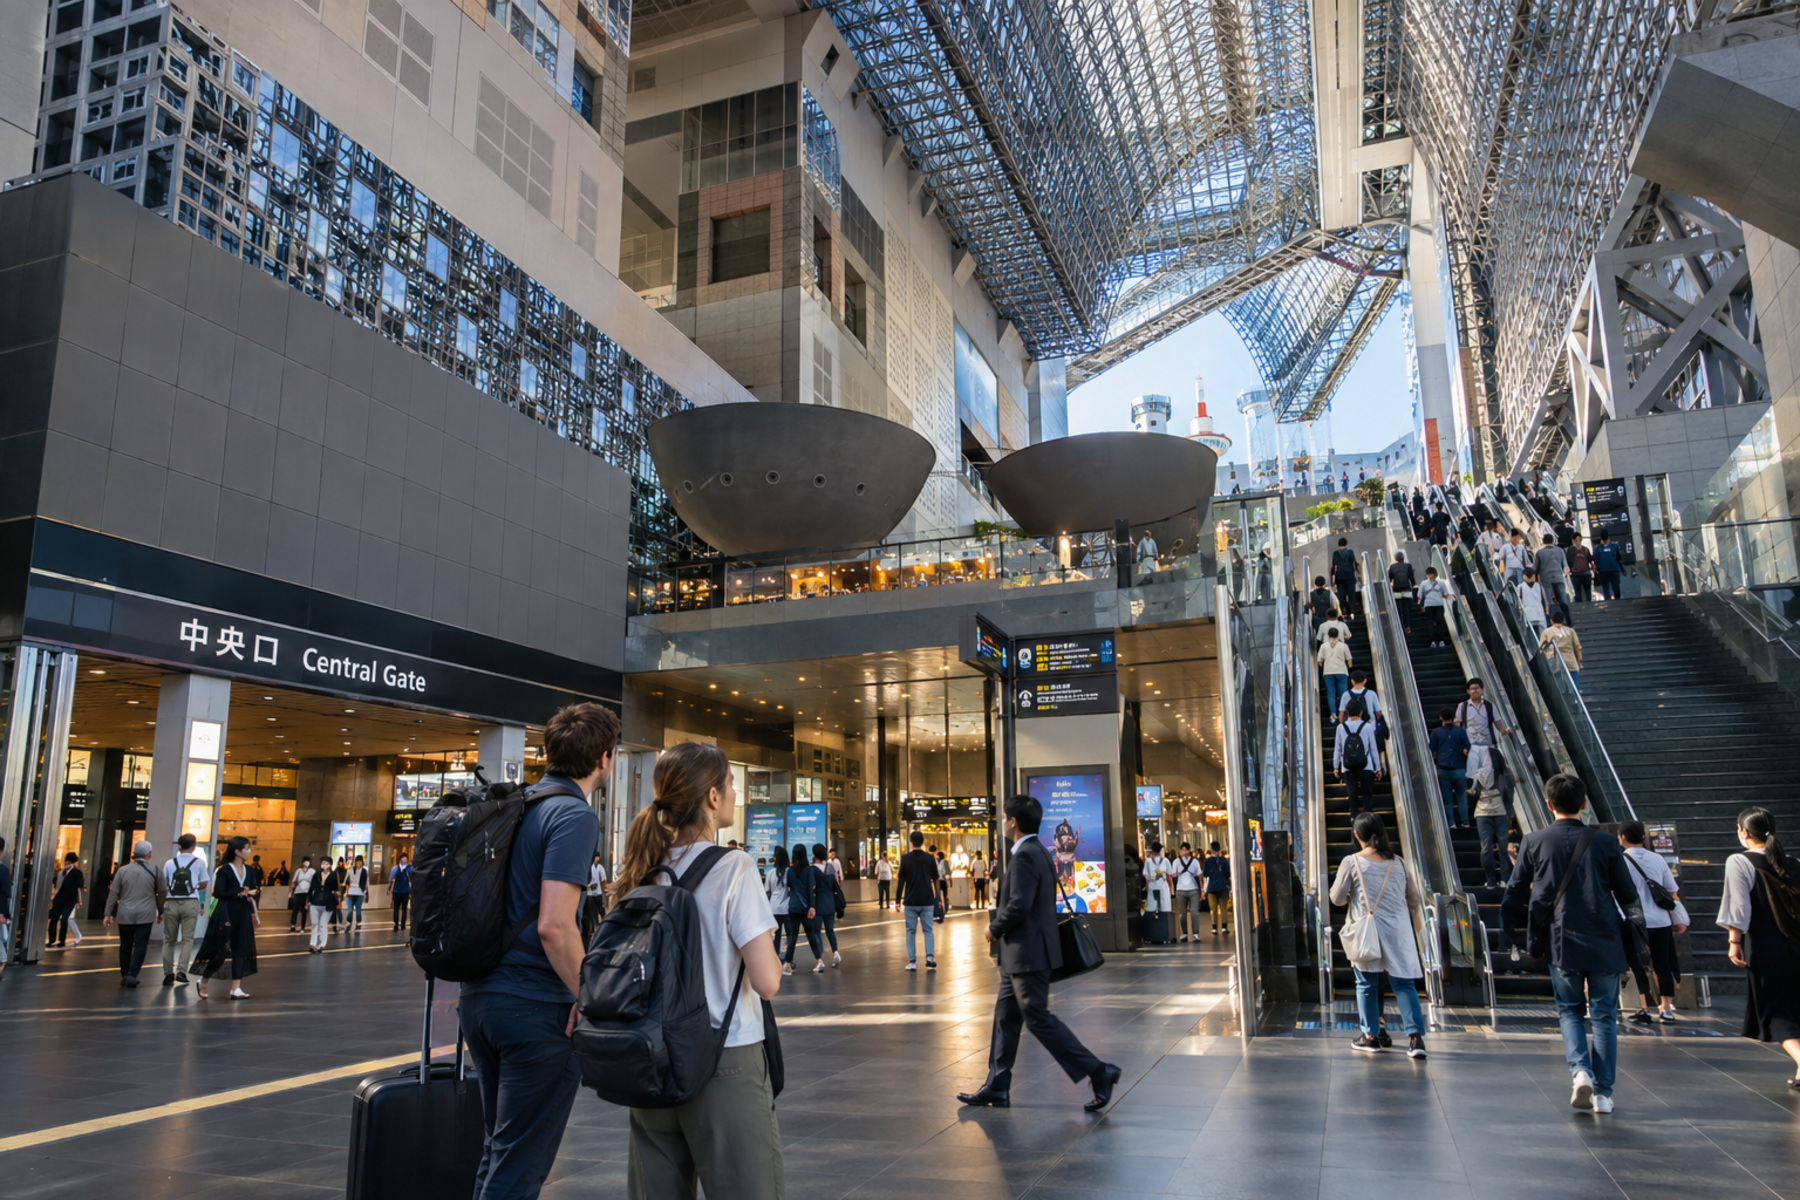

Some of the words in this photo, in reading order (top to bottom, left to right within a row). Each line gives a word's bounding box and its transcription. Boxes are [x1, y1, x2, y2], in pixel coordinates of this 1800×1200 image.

[179, 618, 279, 666] 中央口
[302, 647, 377, 683] Central
[382, 665, 427, 692] Gate
